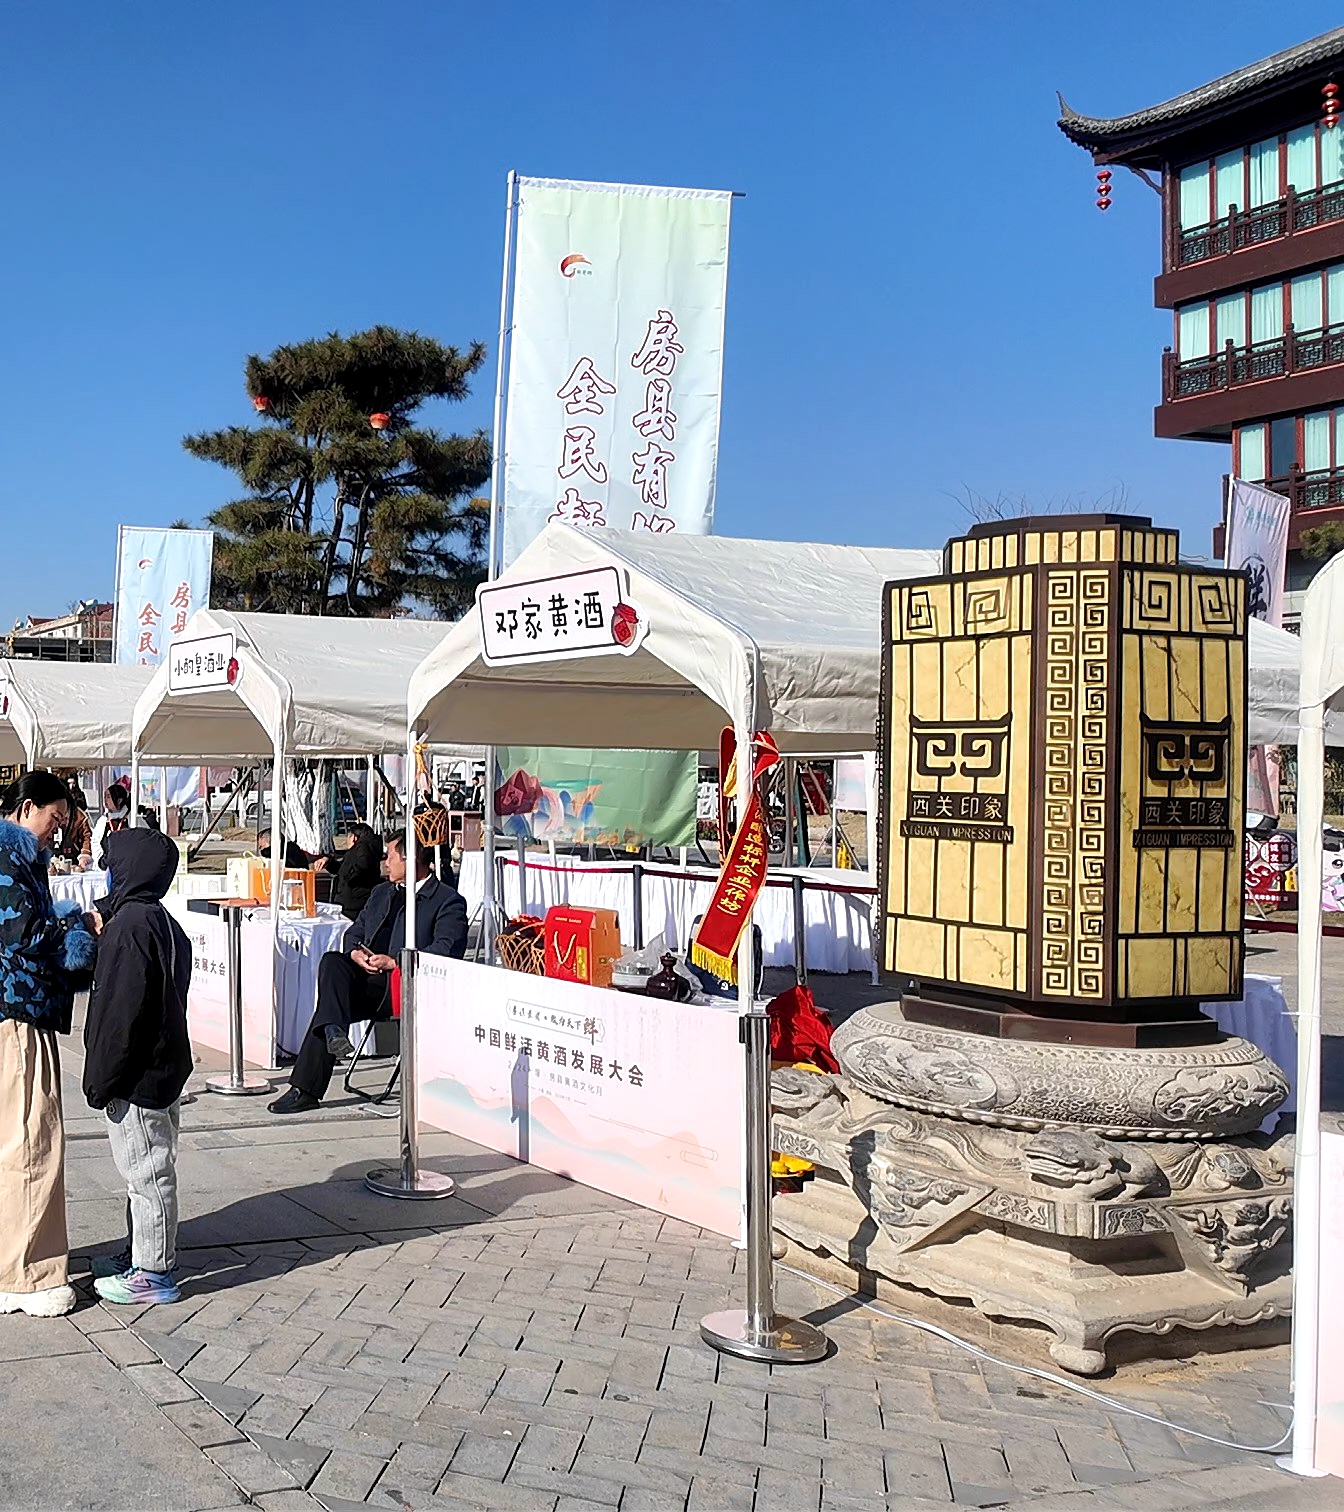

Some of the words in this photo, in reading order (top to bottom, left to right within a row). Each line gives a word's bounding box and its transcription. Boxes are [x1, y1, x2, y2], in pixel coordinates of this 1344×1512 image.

[494, 590, 605, 640] 邓家黄酒
[137, 602, 162, 668] 全民
[912, 794, 1003, 820] 西关印象
[1144, 800, 1225, 825] 西关印象
[902, 825, 940, 837] XIGUAN
[947, 826, 1012, 842] IMPRESSION
[1134, 833, 1170, 846] XIGUAN
[1176, 833, 1233, 846] IMPRESSION
[474, 1024, 644, 1088] 中国鲜活黄酒发展大会
